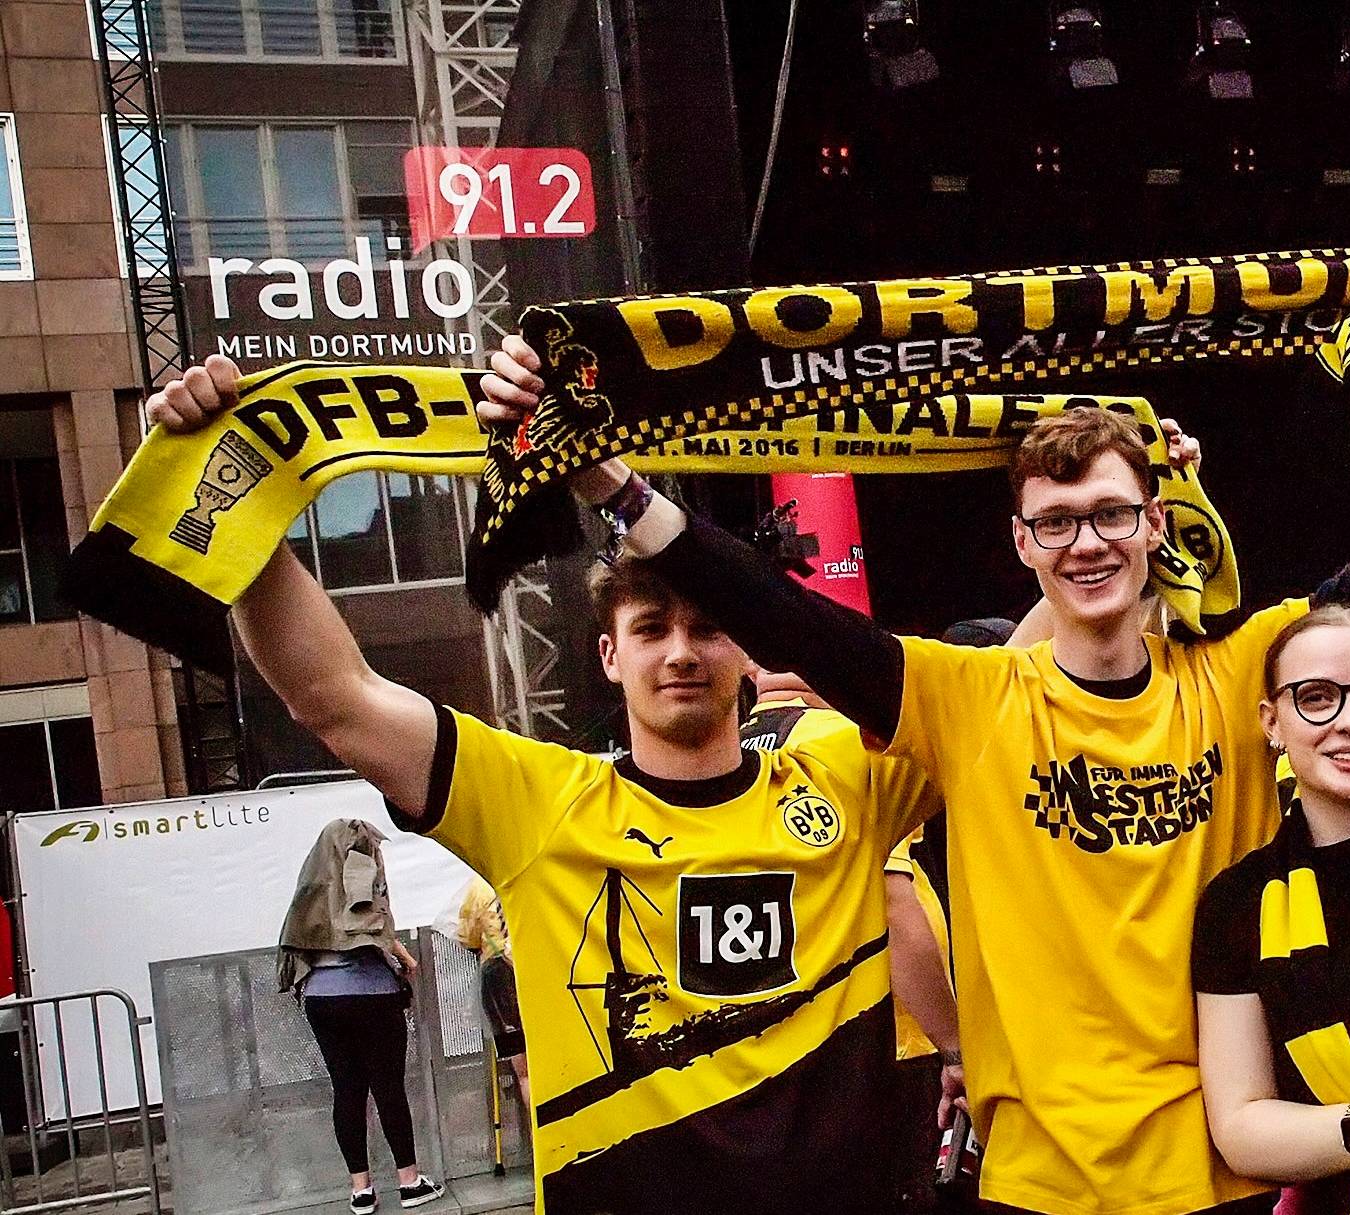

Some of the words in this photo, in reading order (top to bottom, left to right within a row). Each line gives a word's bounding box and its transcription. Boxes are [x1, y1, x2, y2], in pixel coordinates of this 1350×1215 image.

[439, 163, 585, 234] 91.2
[208, 237, 474, 320] radio
[216, 334, 297, 359] MEIN
[310, 332, 477, 357] DORTMUND
[761, 337, 984, 389] UNSER
[683, 438, 732, 457] MAI
[738, 438, 800, 457] 2016
[835, 440, 913, 457] BERLIN
[824, 558, 859, 573] radio
[1130, 763, 1179, 781] IMMER
[113, 804, 270, 838] smartlite
[790, 800, 834, 837] BVB
[813, 829, 829, 842] 09
[690, 901, 782, 964] 1&1
